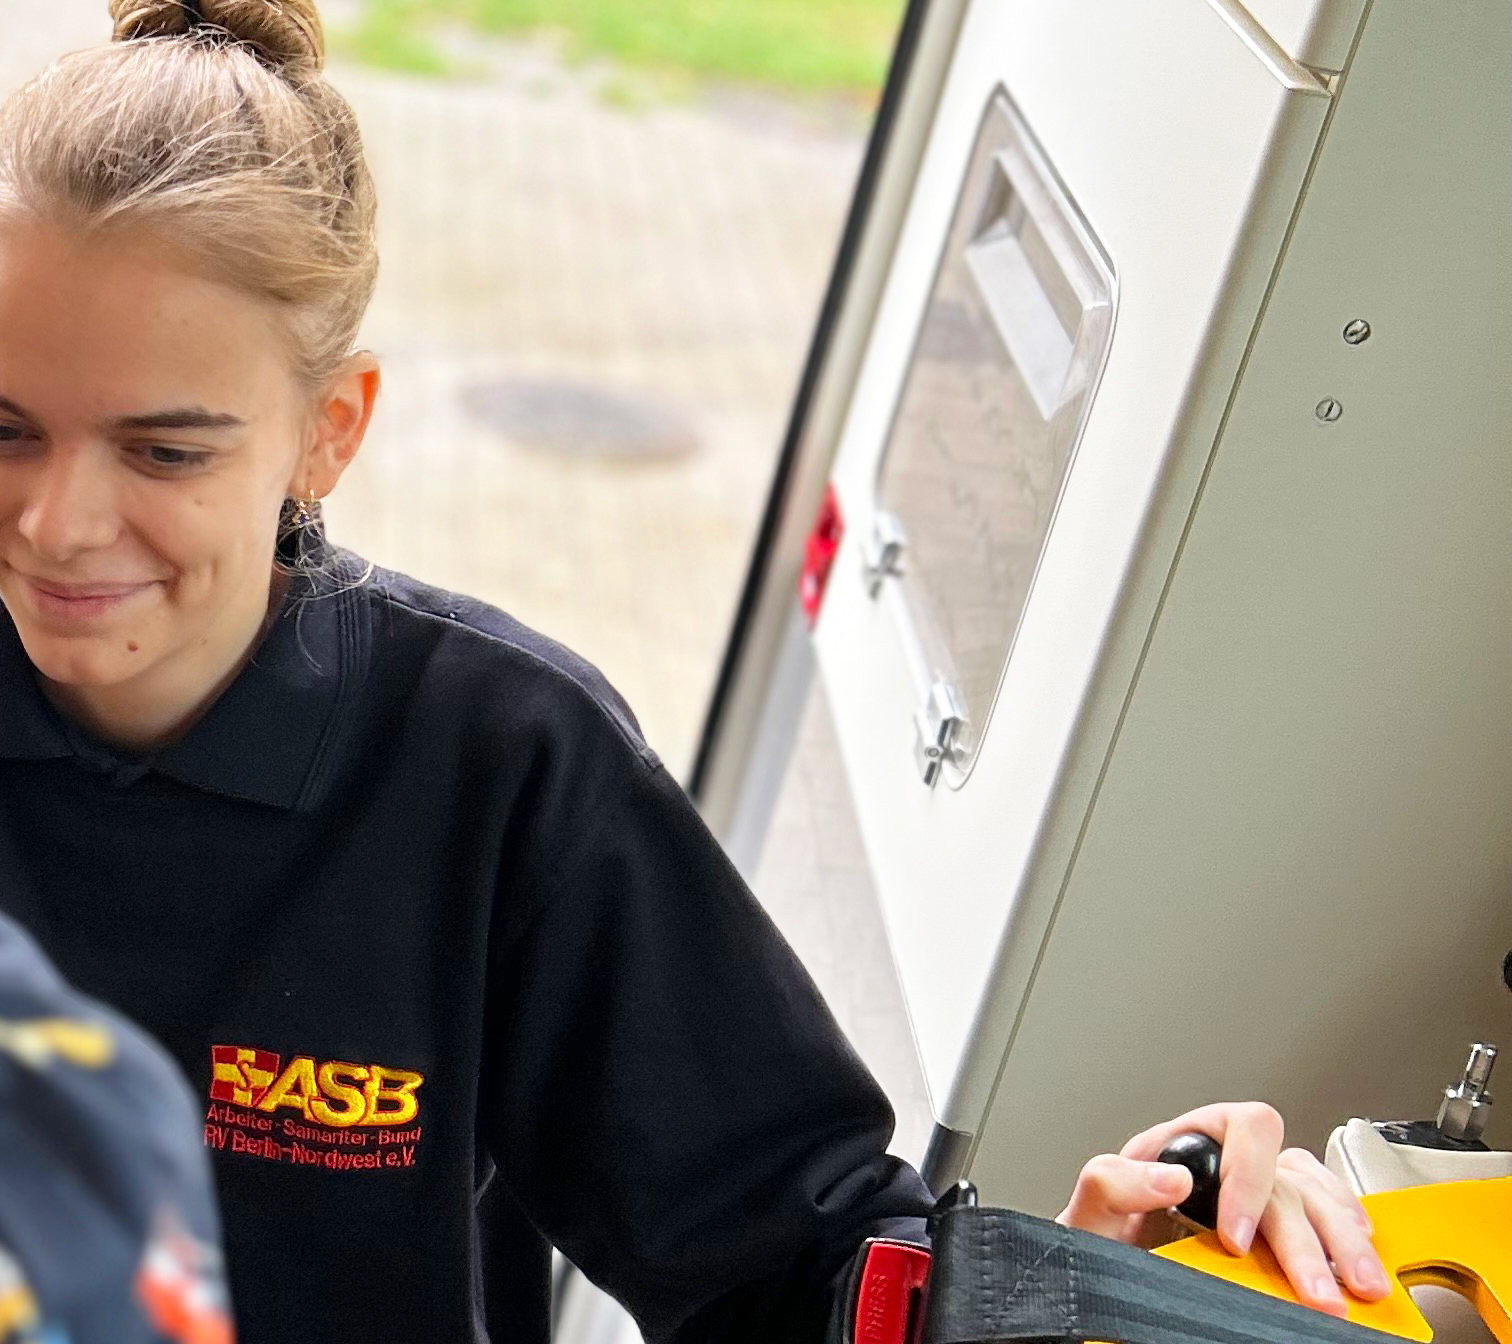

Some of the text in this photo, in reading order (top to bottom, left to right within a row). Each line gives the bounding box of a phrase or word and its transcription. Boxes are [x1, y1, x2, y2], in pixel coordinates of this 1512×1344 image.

[257, 1055, 425, 1127] ASB
[203, 1123, 417, 1171] RV Berlin-Nordwest e.V.
[206, 1103, 422, 1147] Arbeiter-Samariter-Bund
